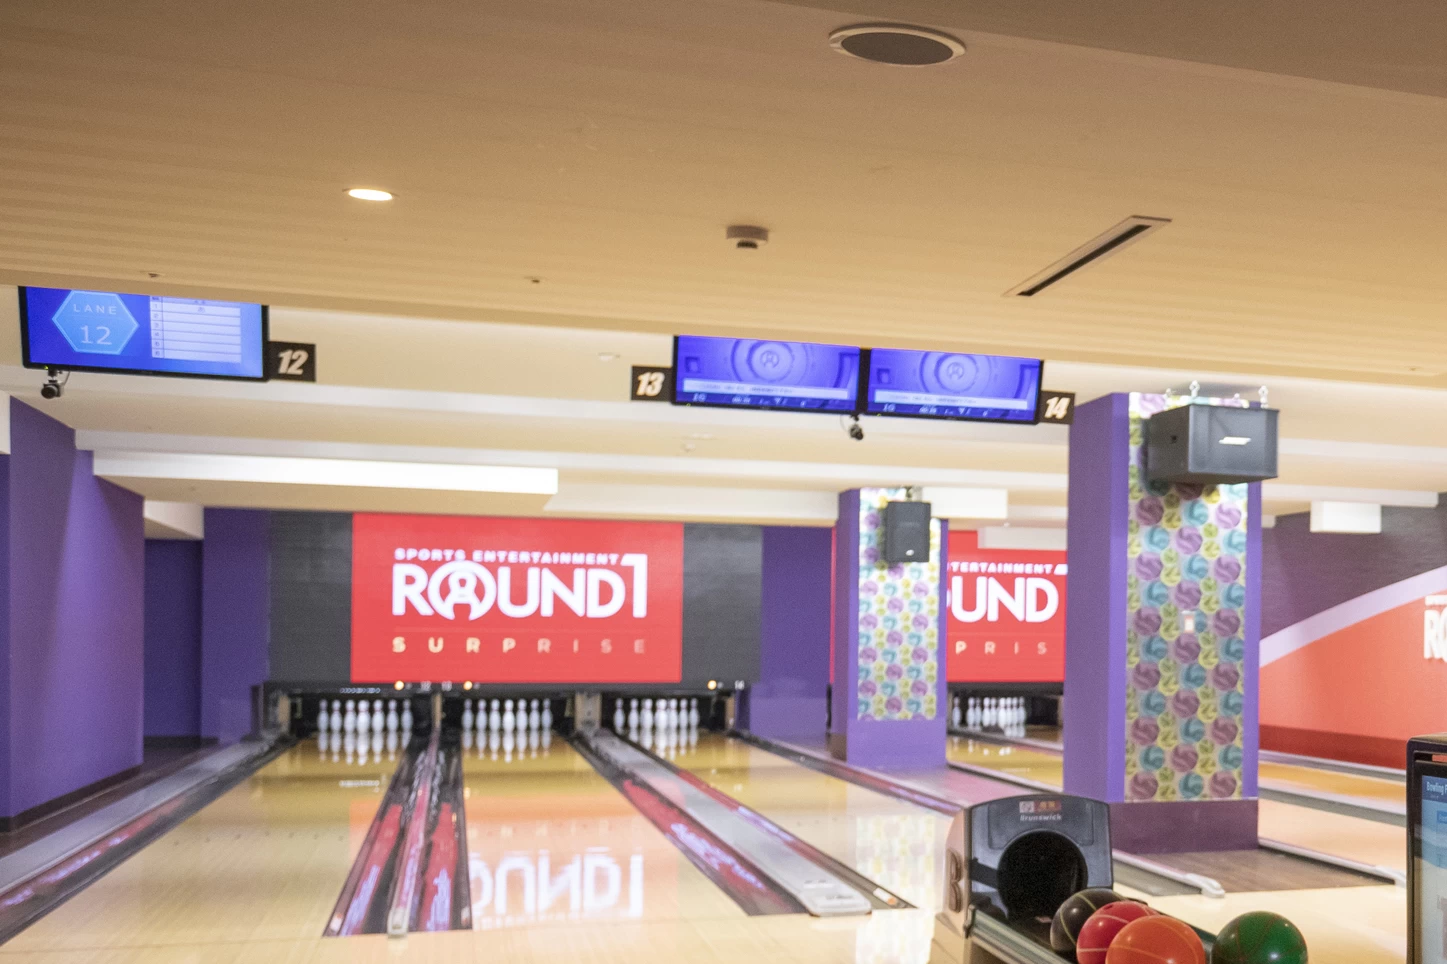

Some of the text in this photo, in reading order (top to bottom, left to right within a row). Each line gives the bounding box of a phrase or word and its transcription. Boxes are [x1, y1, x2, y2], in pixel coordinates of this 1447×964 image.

[73, 304, 117, 315] LANE
[80, 325, 111, 345] 12
[278, 350, 308, 375] 12
[637, 372, 664, 396] 13
[1045, 397, 1070, 419] 14
[394, 548, 619, 564] SPORTS ENTERTAINMENT
[947, 561, 1053, 574] TERTAINMENT
[392, 554, 648, 621] ROUND1
[947, 575, 1059, 623] UND
[392, 637, 645, 653] SURPRISE
[1427, 781, 1444, 795] Bowling
